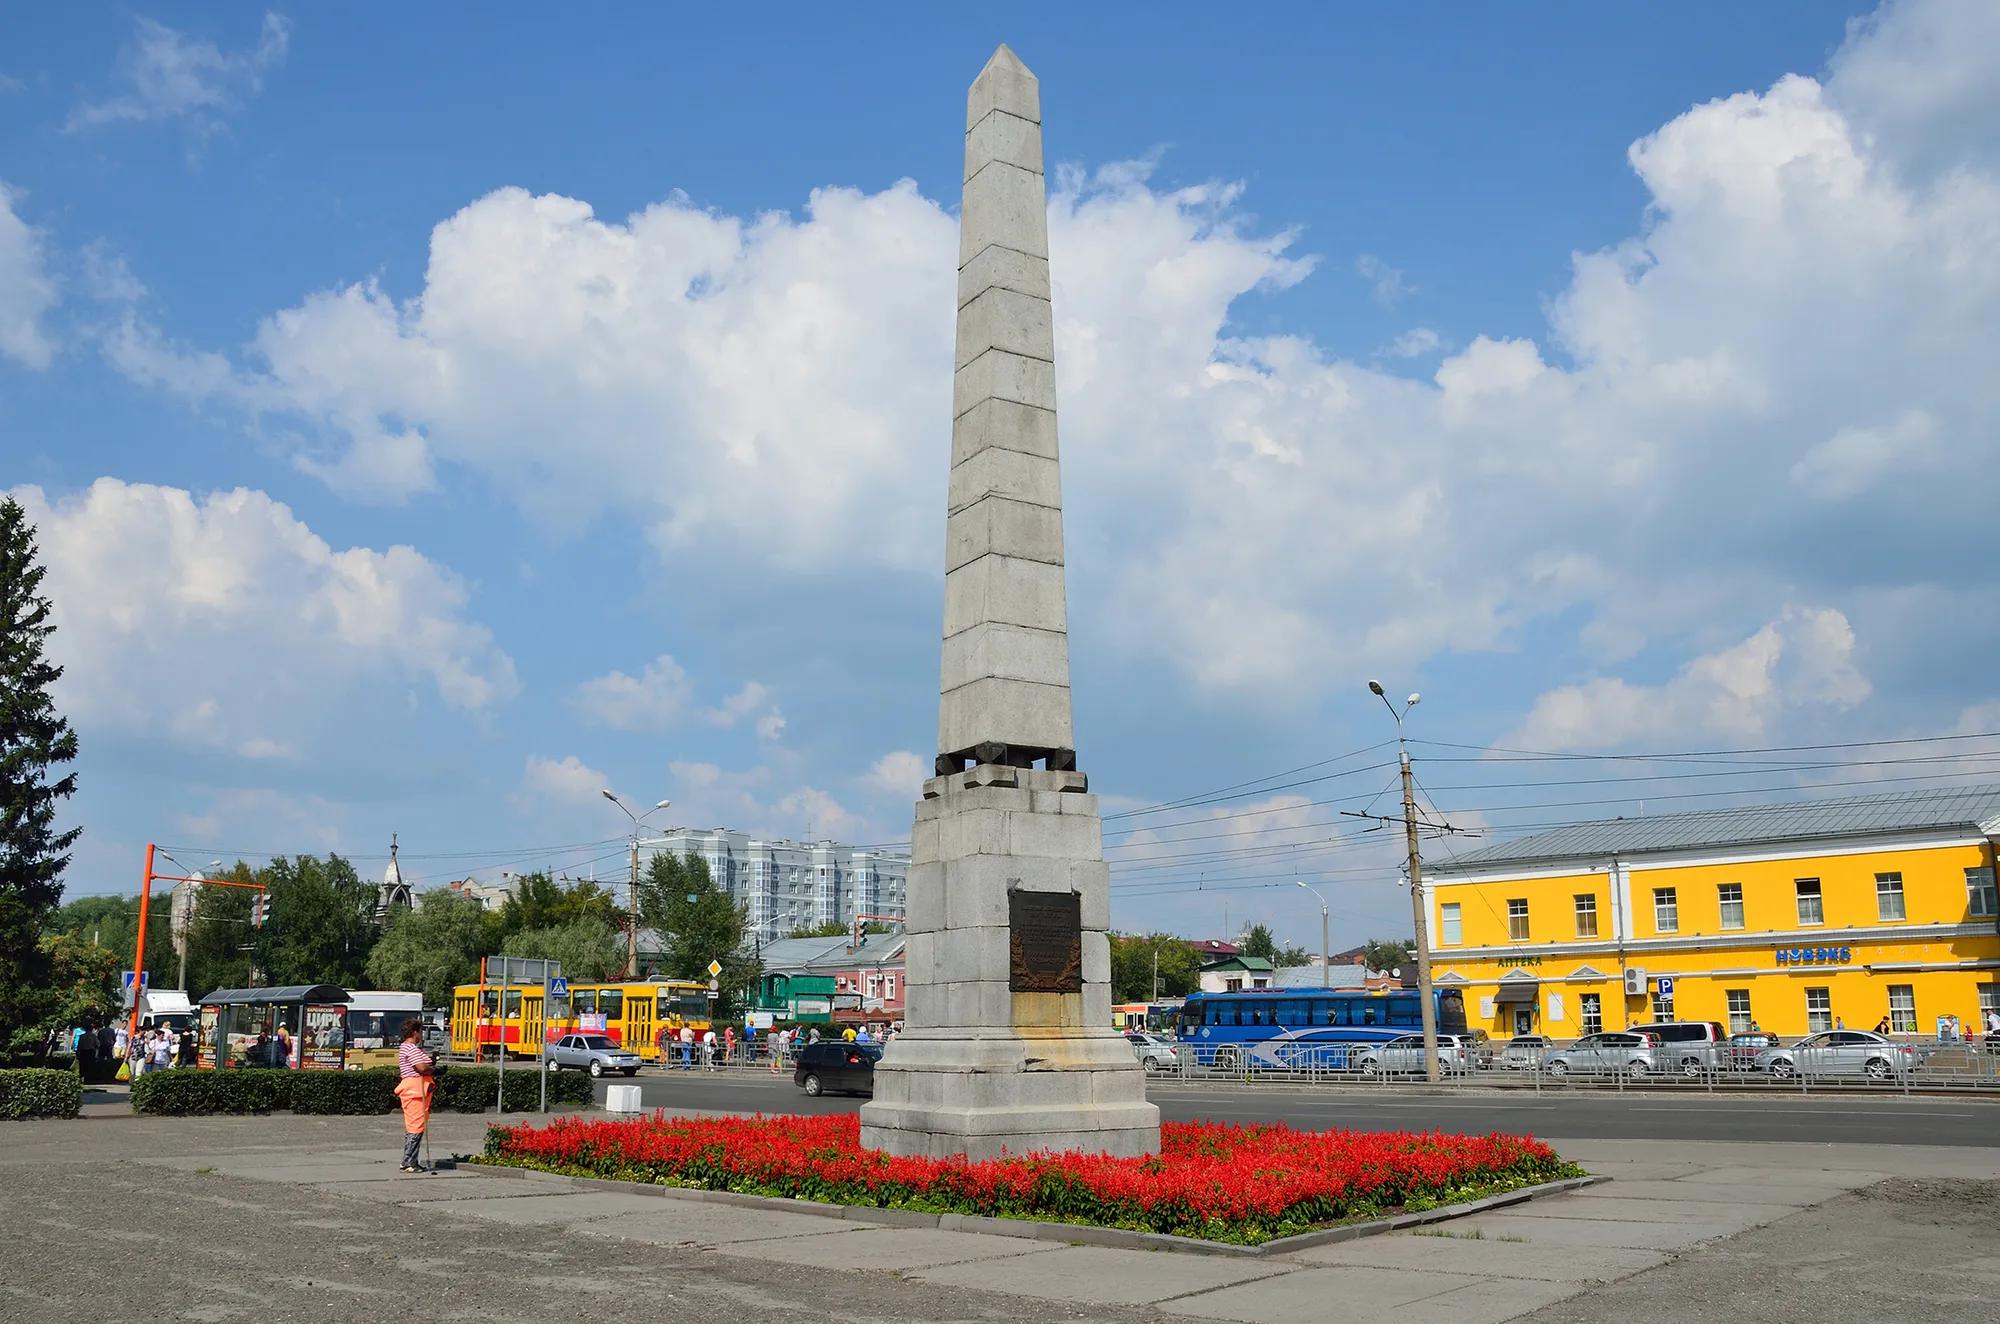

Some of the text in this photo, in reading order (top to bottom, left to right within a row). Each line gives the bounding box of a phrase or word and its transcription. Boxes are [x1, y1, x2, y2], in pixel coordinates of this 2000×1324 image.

[1776, 946, 1852, 962] НОВЭКС
[1497, 956, 1542, 968] АПТЕКА
[1661, 979, 1671, 992] P
[306, 1012, 342, 1028] ЦИРК
